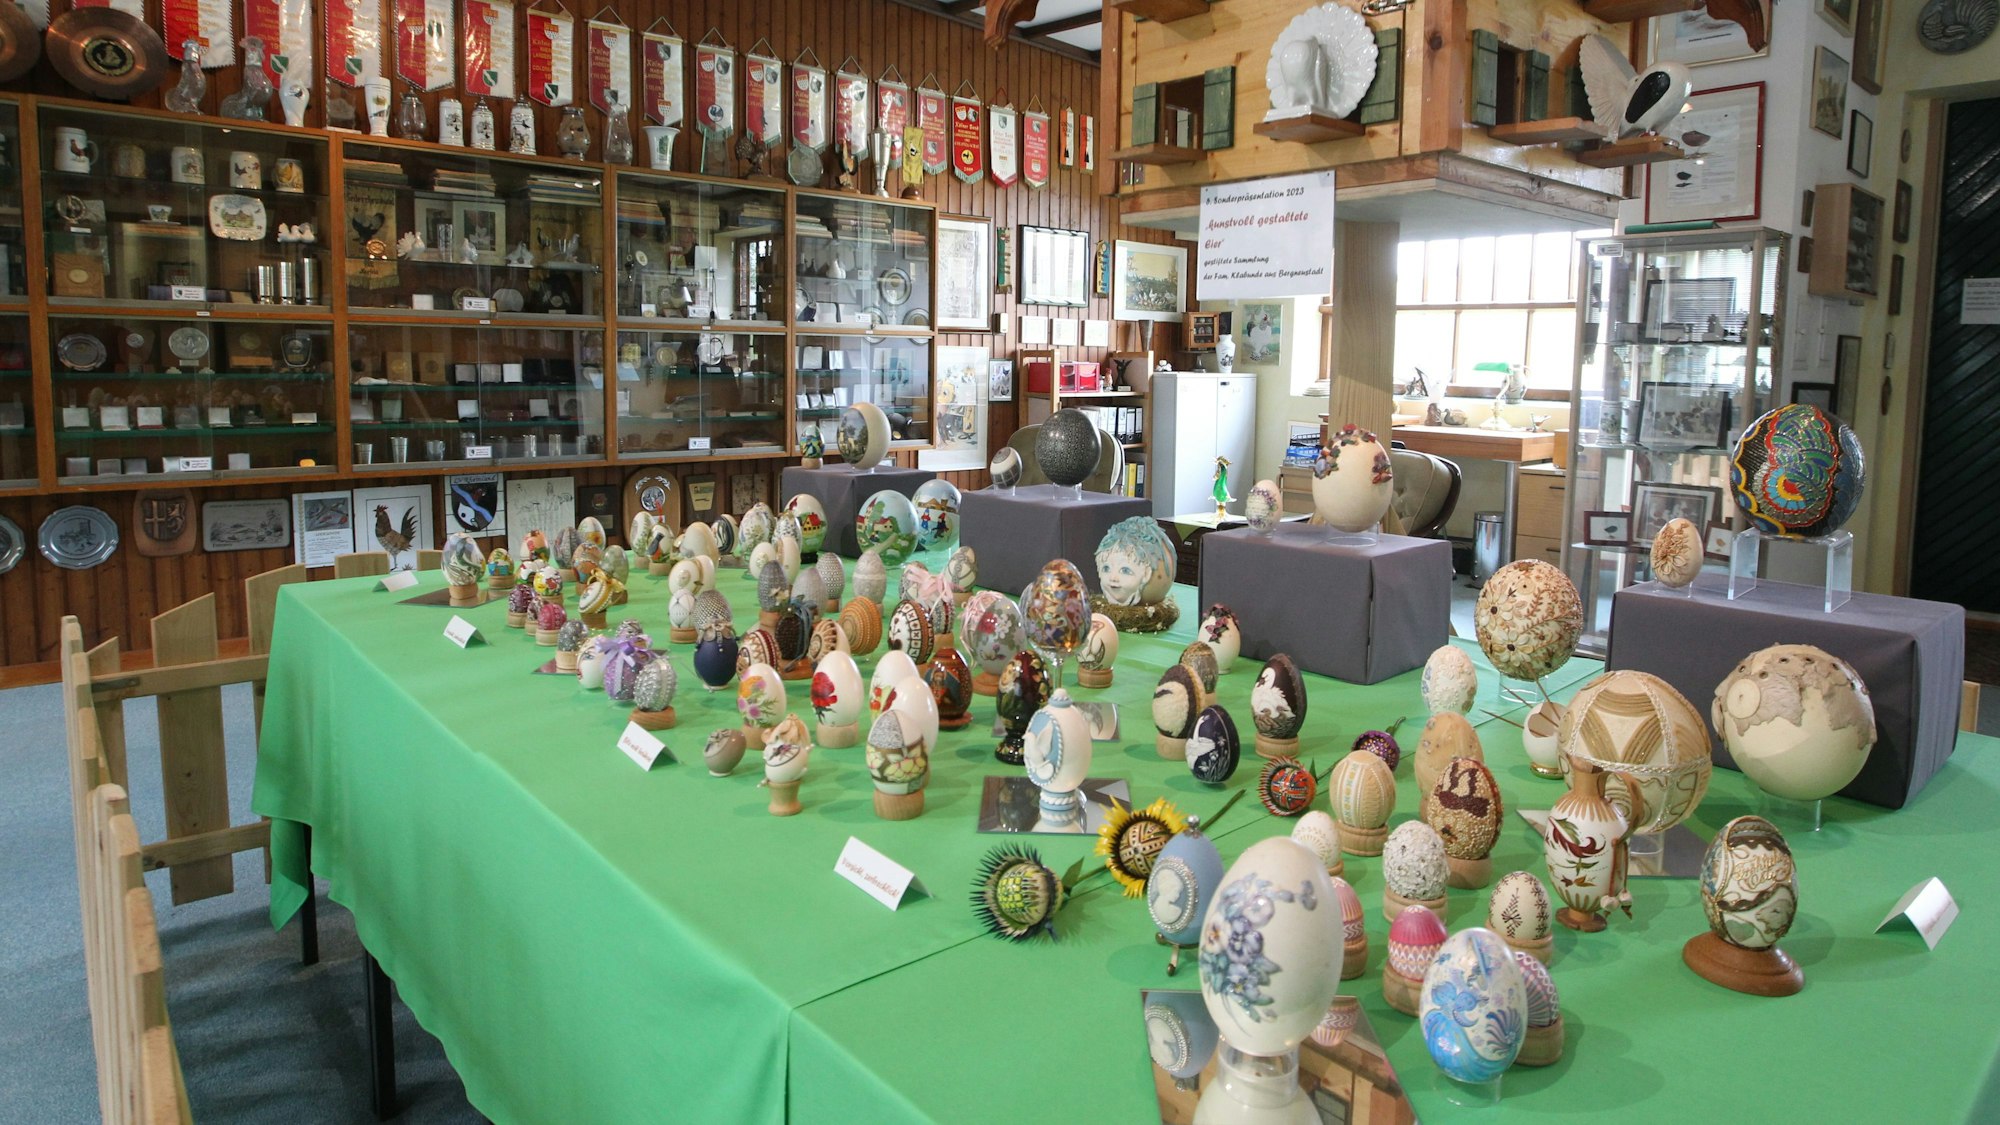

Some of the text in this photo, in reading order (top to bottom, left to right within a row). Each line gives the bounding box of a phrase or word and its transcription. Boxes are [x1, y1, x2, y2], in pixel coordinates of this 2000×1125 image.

[1213, 190, 1284, 205] Sonderpräsentation
[1286, 186, 1305, 197] 2023
[1257, 211, 1309, 227] gestaltete
[1233, 255, 1270, 264] Sammlung
[1278, 267, 1324, 278] Bergneustadt
